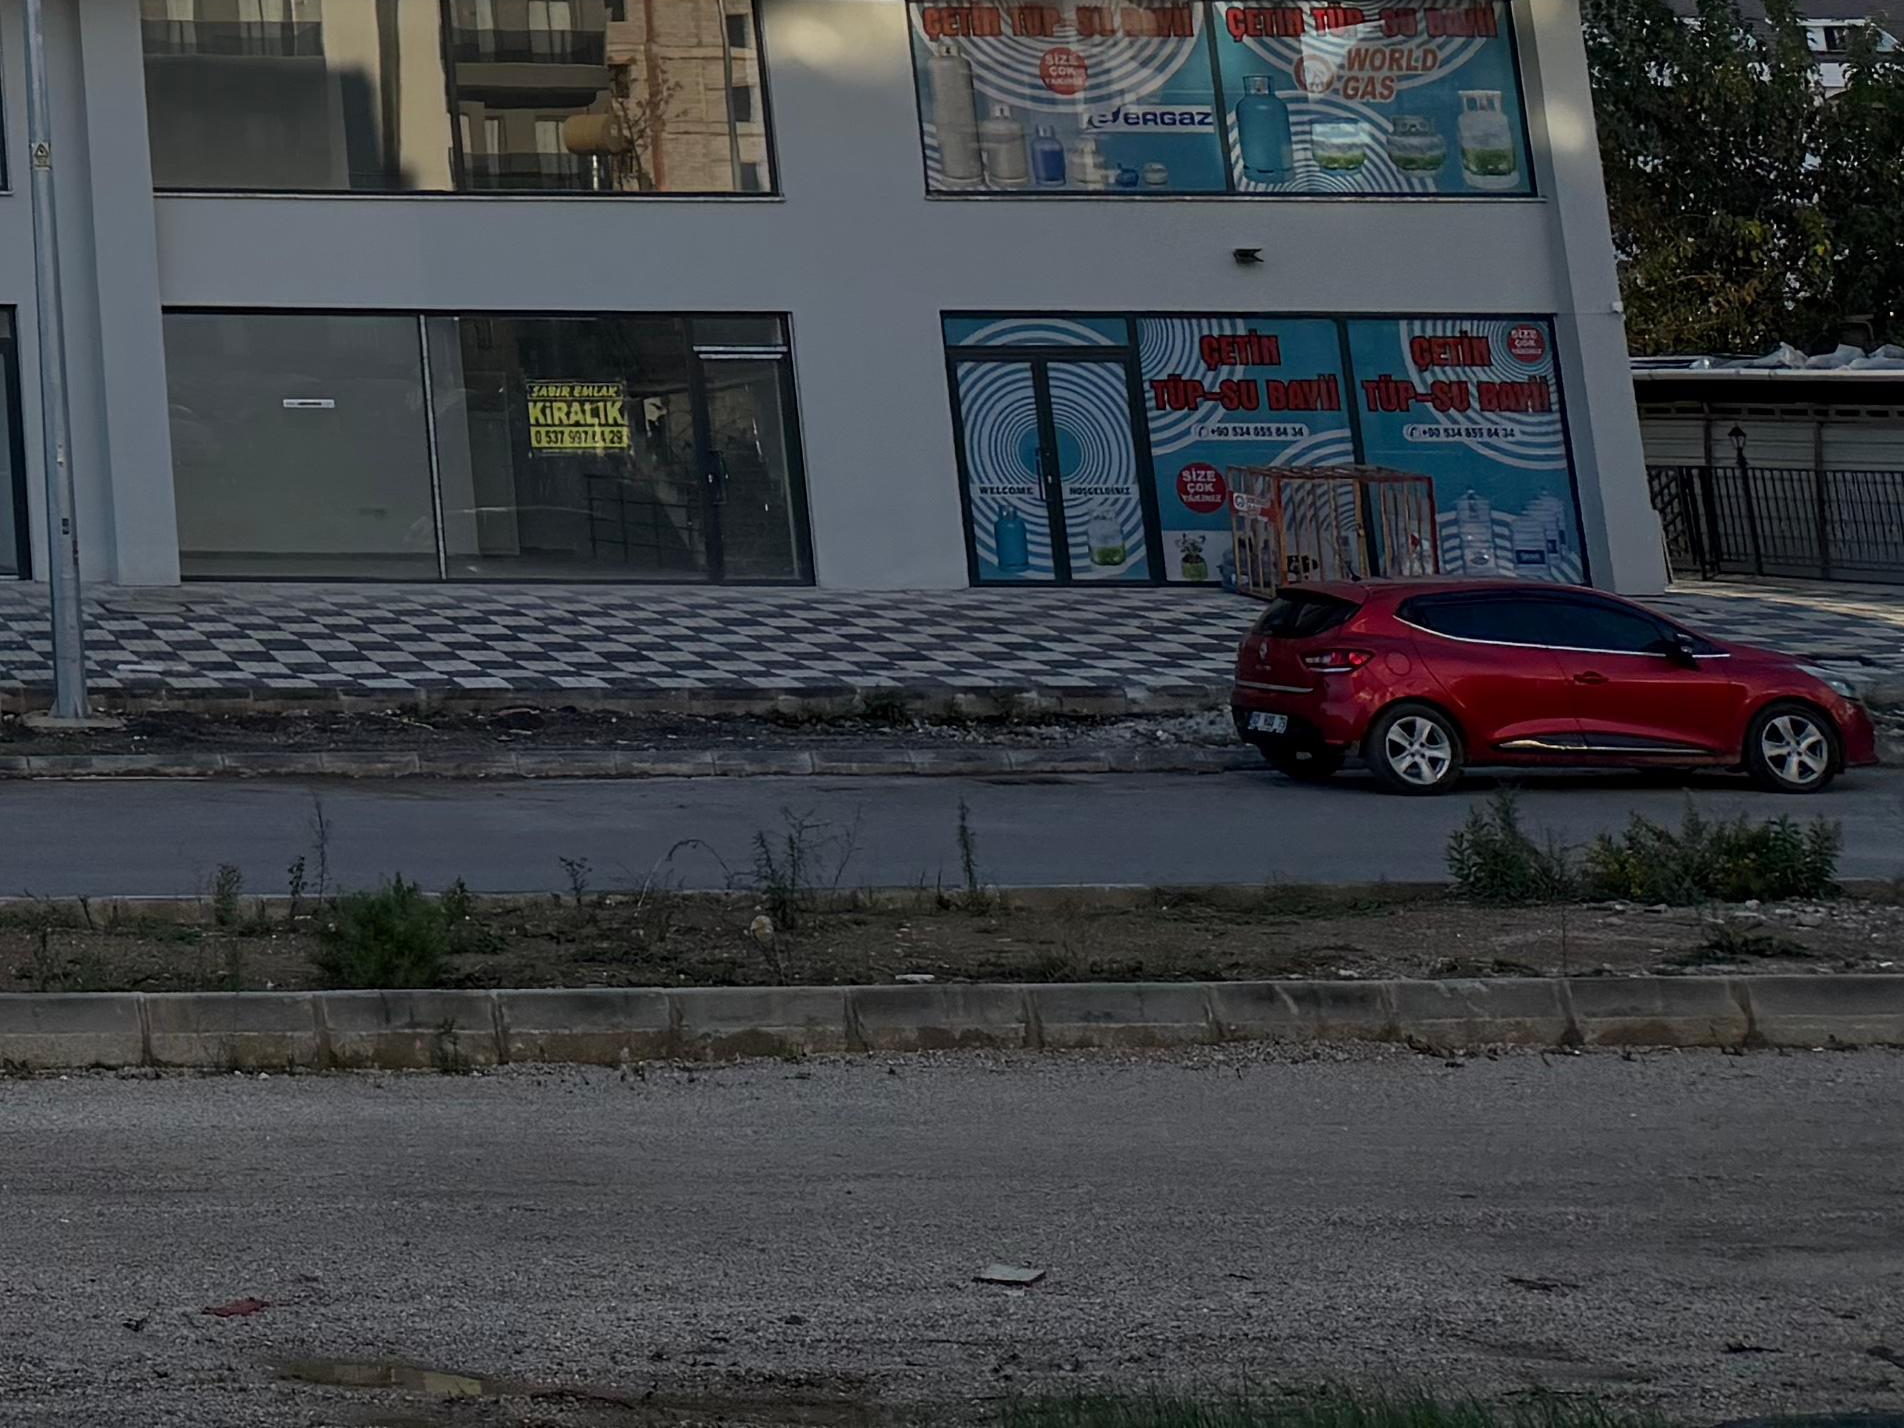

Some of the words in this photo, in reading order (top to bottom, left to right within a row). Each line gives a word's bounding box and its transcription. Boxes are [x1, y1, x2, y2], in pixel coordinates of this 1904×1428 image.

[1344, 46, 1439, 72] WORLD
[1342, 75, 1396, 101] GAS
[1199, 329, 1281, 371] ÇETİN
[1410, 330, 1493, 372] ÇETİN
[573, 385, 618, 397] EMLAK
[534, 430, 541, 444] 0
[545, 430, 565, 444] 537
[568, 430, 588, 444] 997
[1232, 426, 1251, 437] 534
[1291, 426, 1304, 437] 34
[1182, 468, 1216, 481] SİZE
[978, 486, 1033, 494] WELCOME
[1186, 482, 1214, 494] ÇOK
